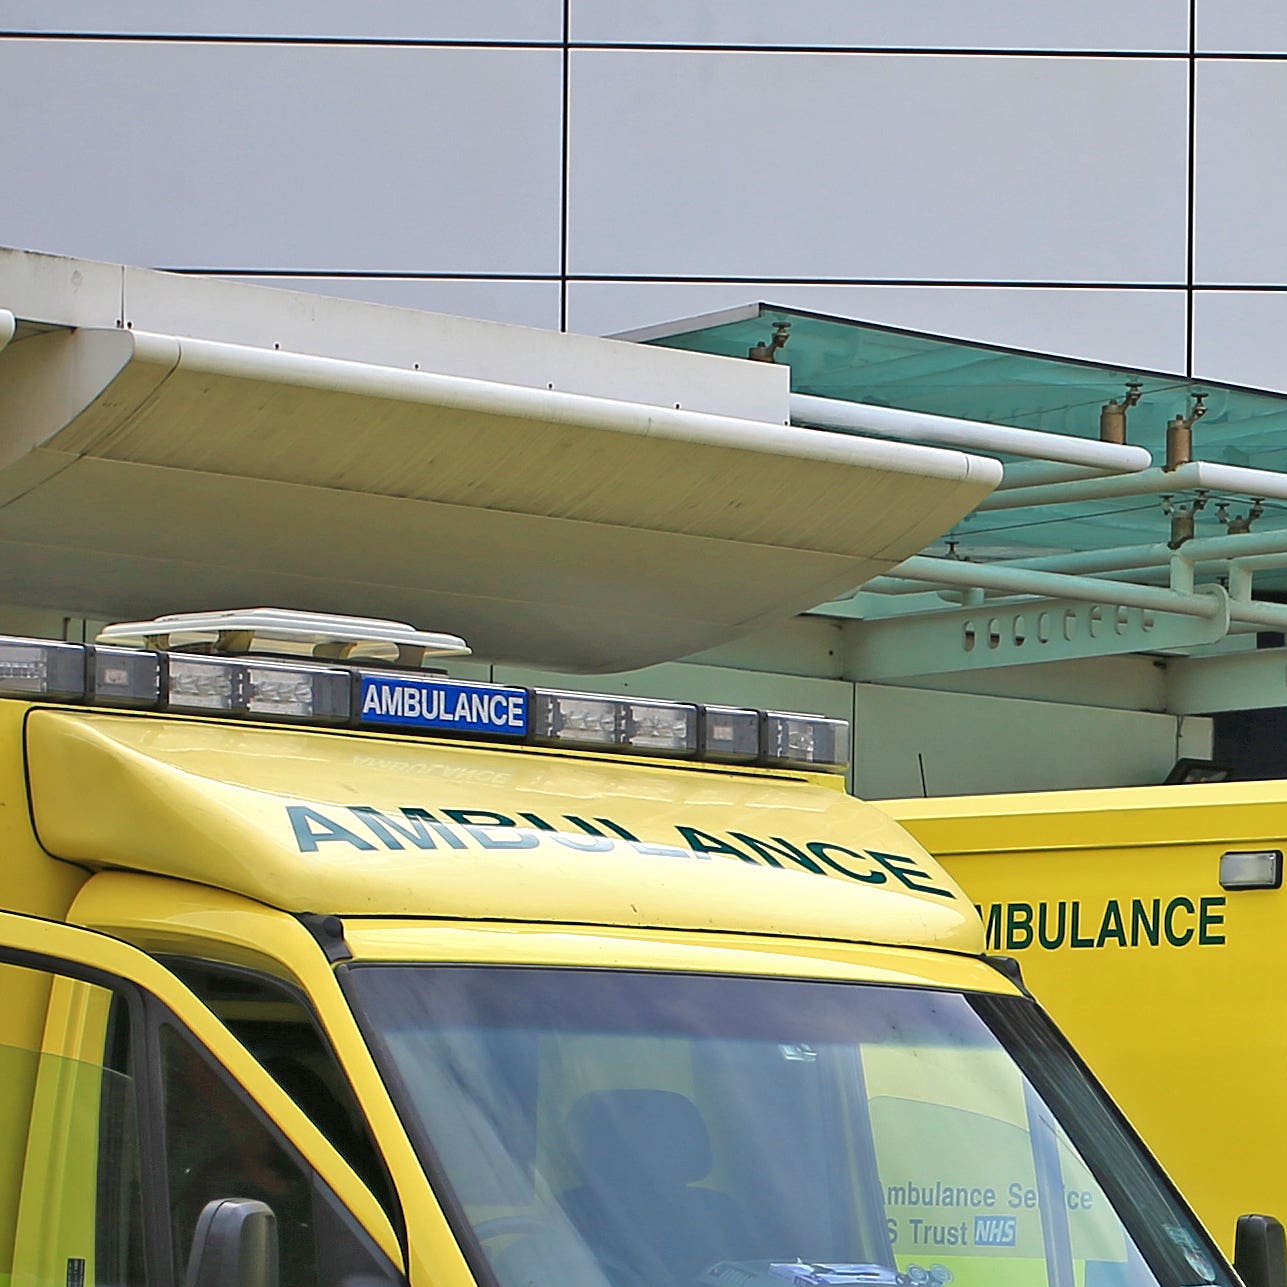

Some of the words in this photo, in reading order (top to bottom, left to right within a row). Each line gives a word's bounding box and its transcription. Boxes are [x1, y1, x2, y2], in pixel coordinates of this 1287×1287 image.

[363, 685, 523, 726] AMBULANCE
[285, 805, 954, 898] AMBULANCE
[974, 896, 1226, 950] MBULANCE
[887, 1181, 996, 1208] mbulance
[909, 1218, 967, 1245] Trust
[975, 1219, 1015, 1244] NHS
